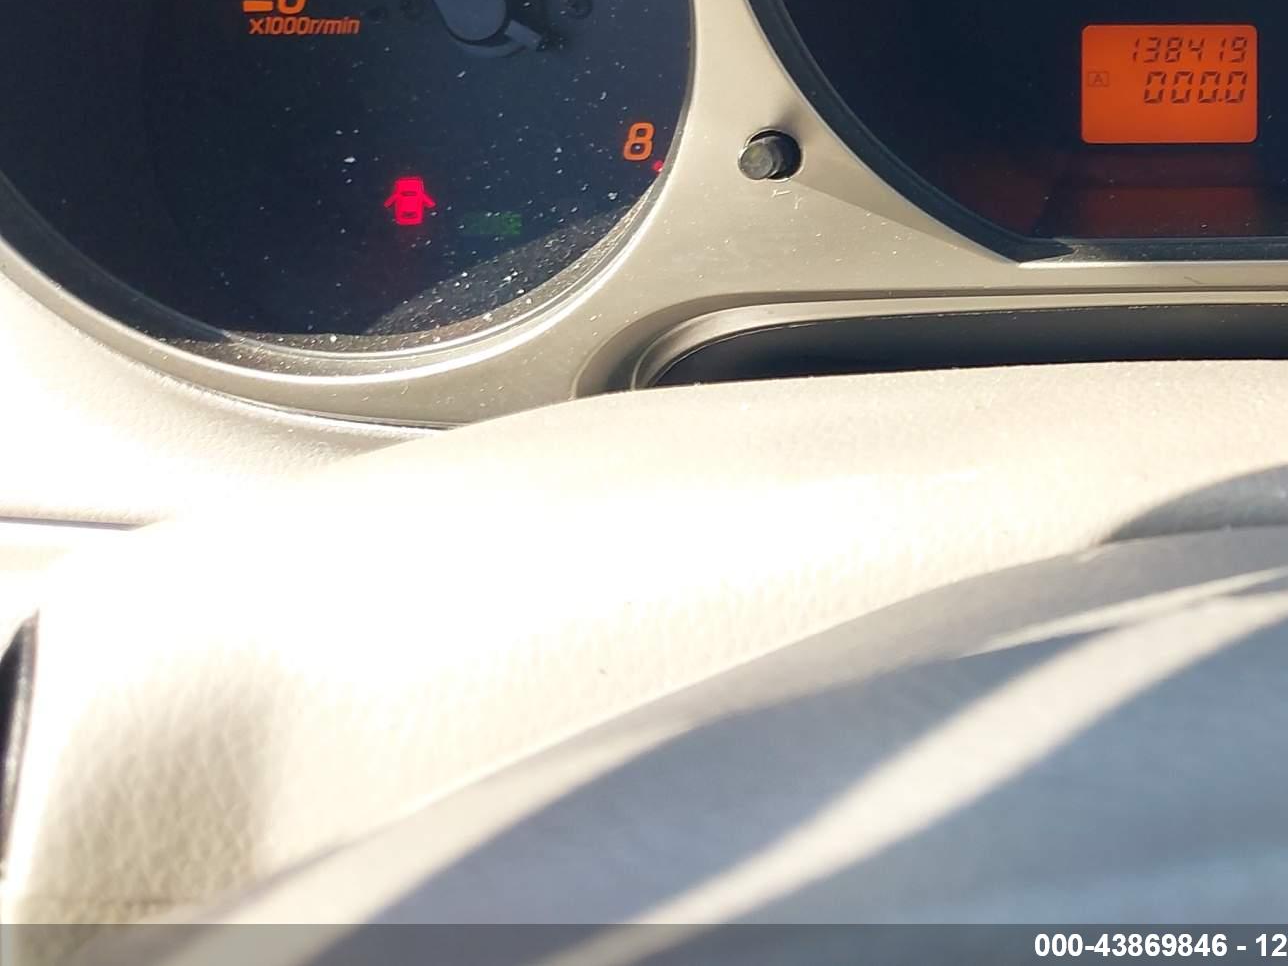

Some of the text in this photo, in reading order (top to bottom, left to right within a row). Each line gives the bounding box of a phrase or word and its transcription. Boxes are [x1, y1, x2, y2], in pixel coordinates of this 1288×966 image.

[1132, 36, 1248, 64] 138419
[1144, 71, 1248, 104] 000.0
[623, 122, 655, 162] 8
